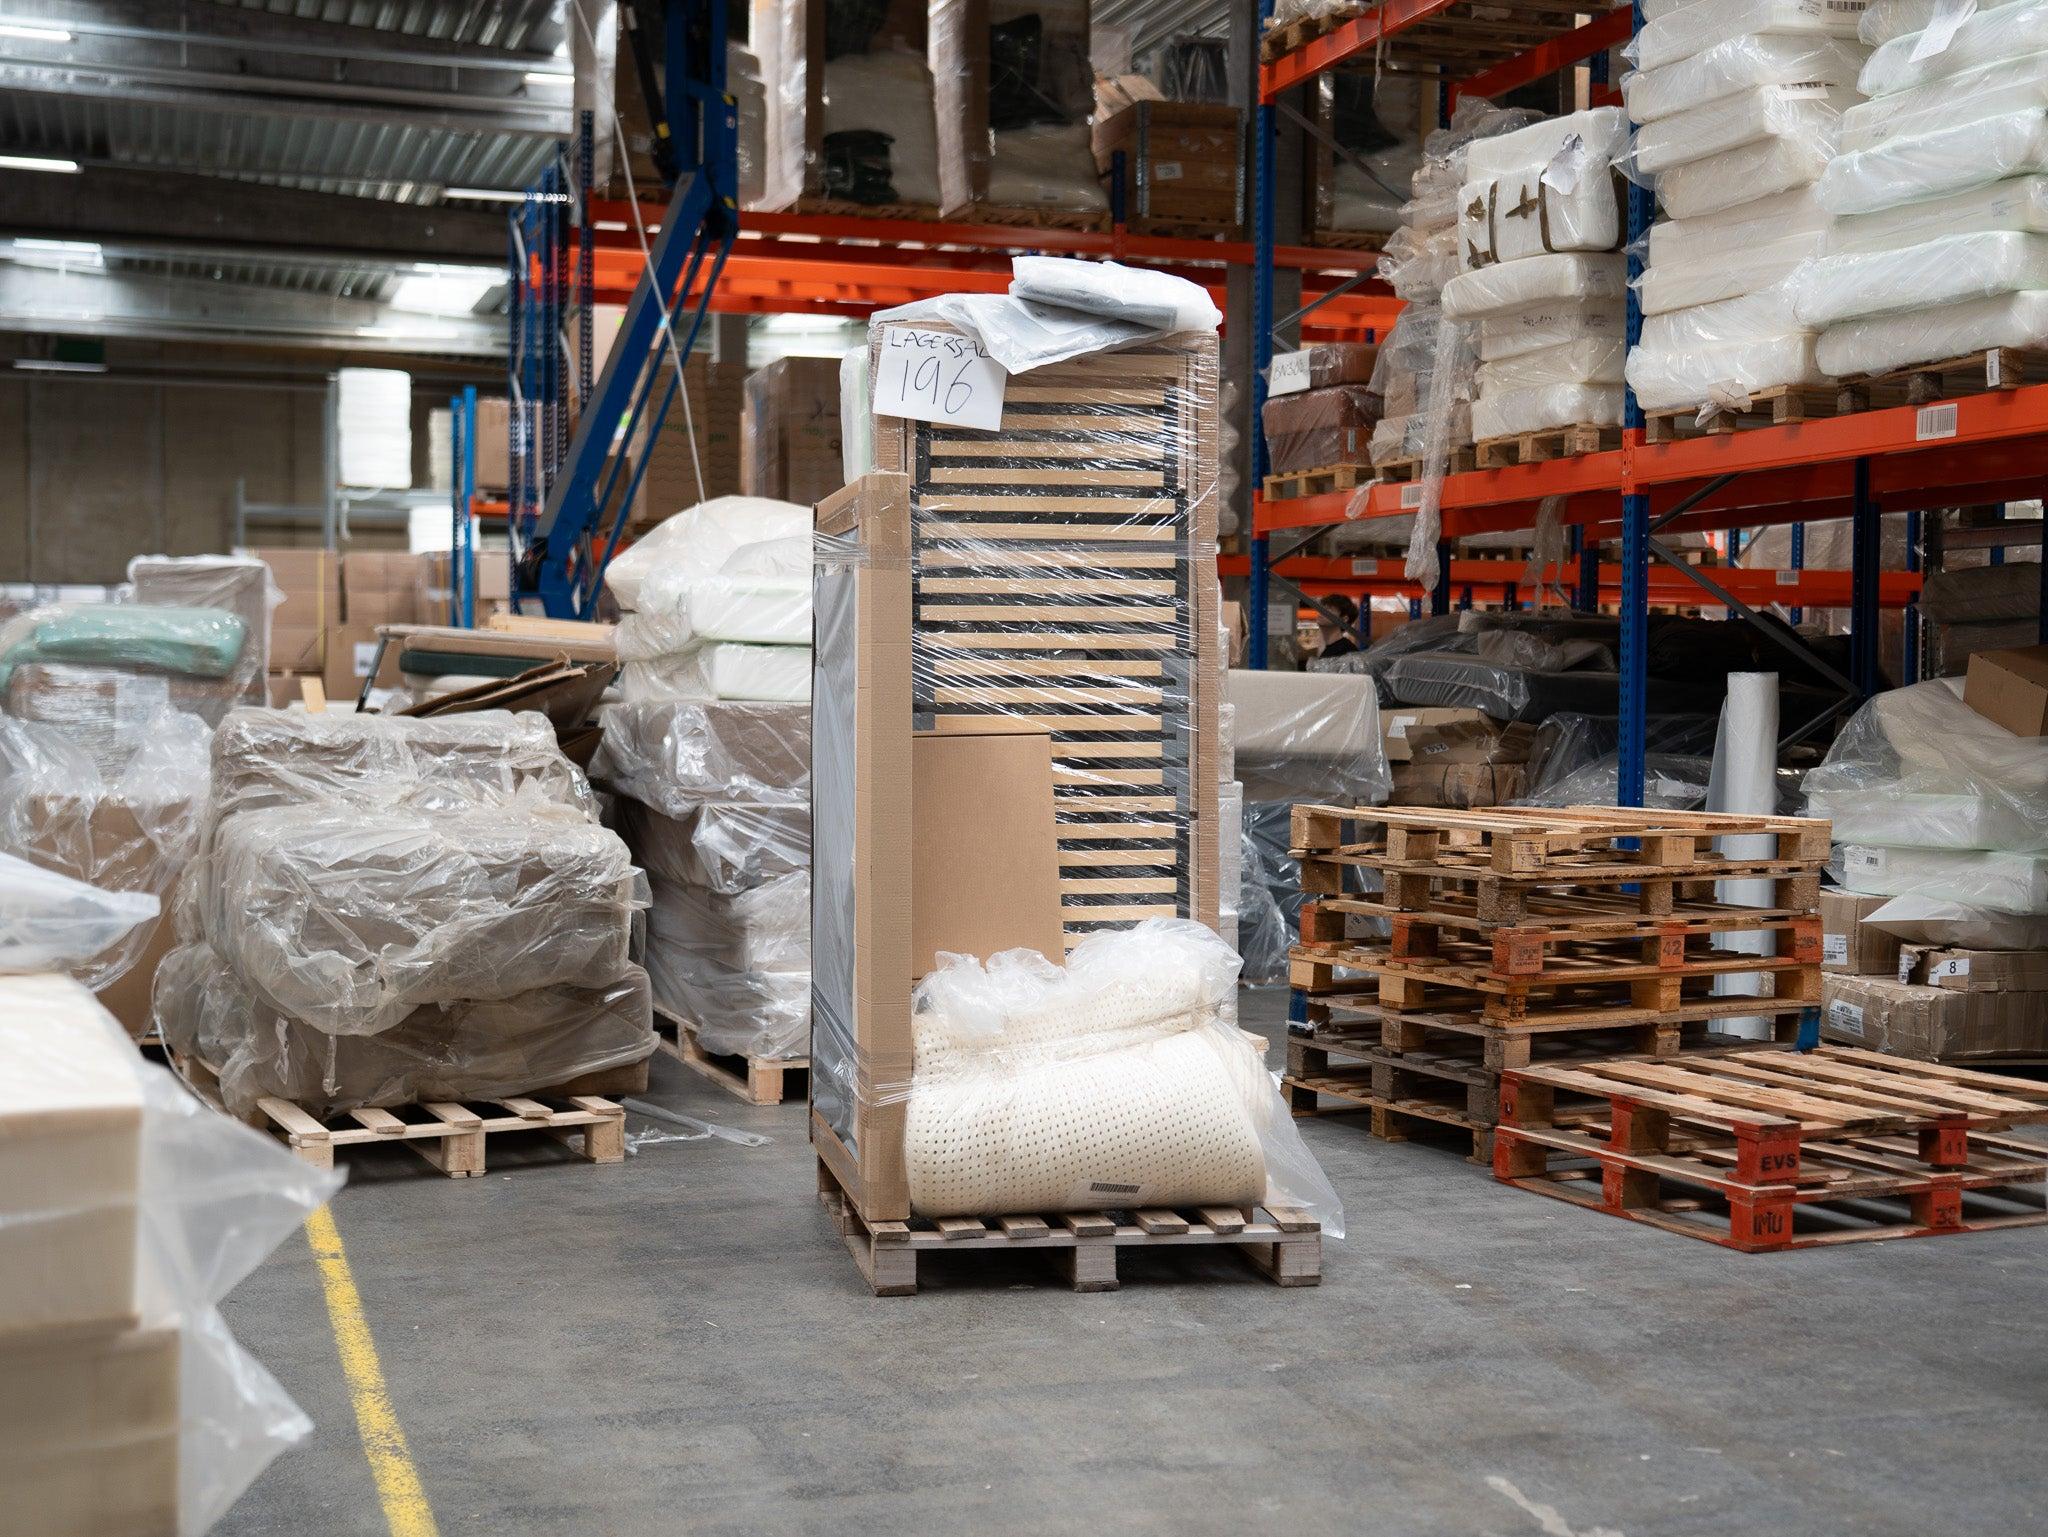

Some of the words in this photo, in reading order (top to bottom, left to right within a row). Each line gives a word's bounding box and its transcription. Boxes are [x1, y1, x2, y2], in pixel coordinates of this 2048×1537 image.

[900, 355, 974, 415] 196
[1663, 940, 1682, 956] 42
[1949, 961, 1957, 974] 8
[1761, 1153, 1797, 1172] EVS
